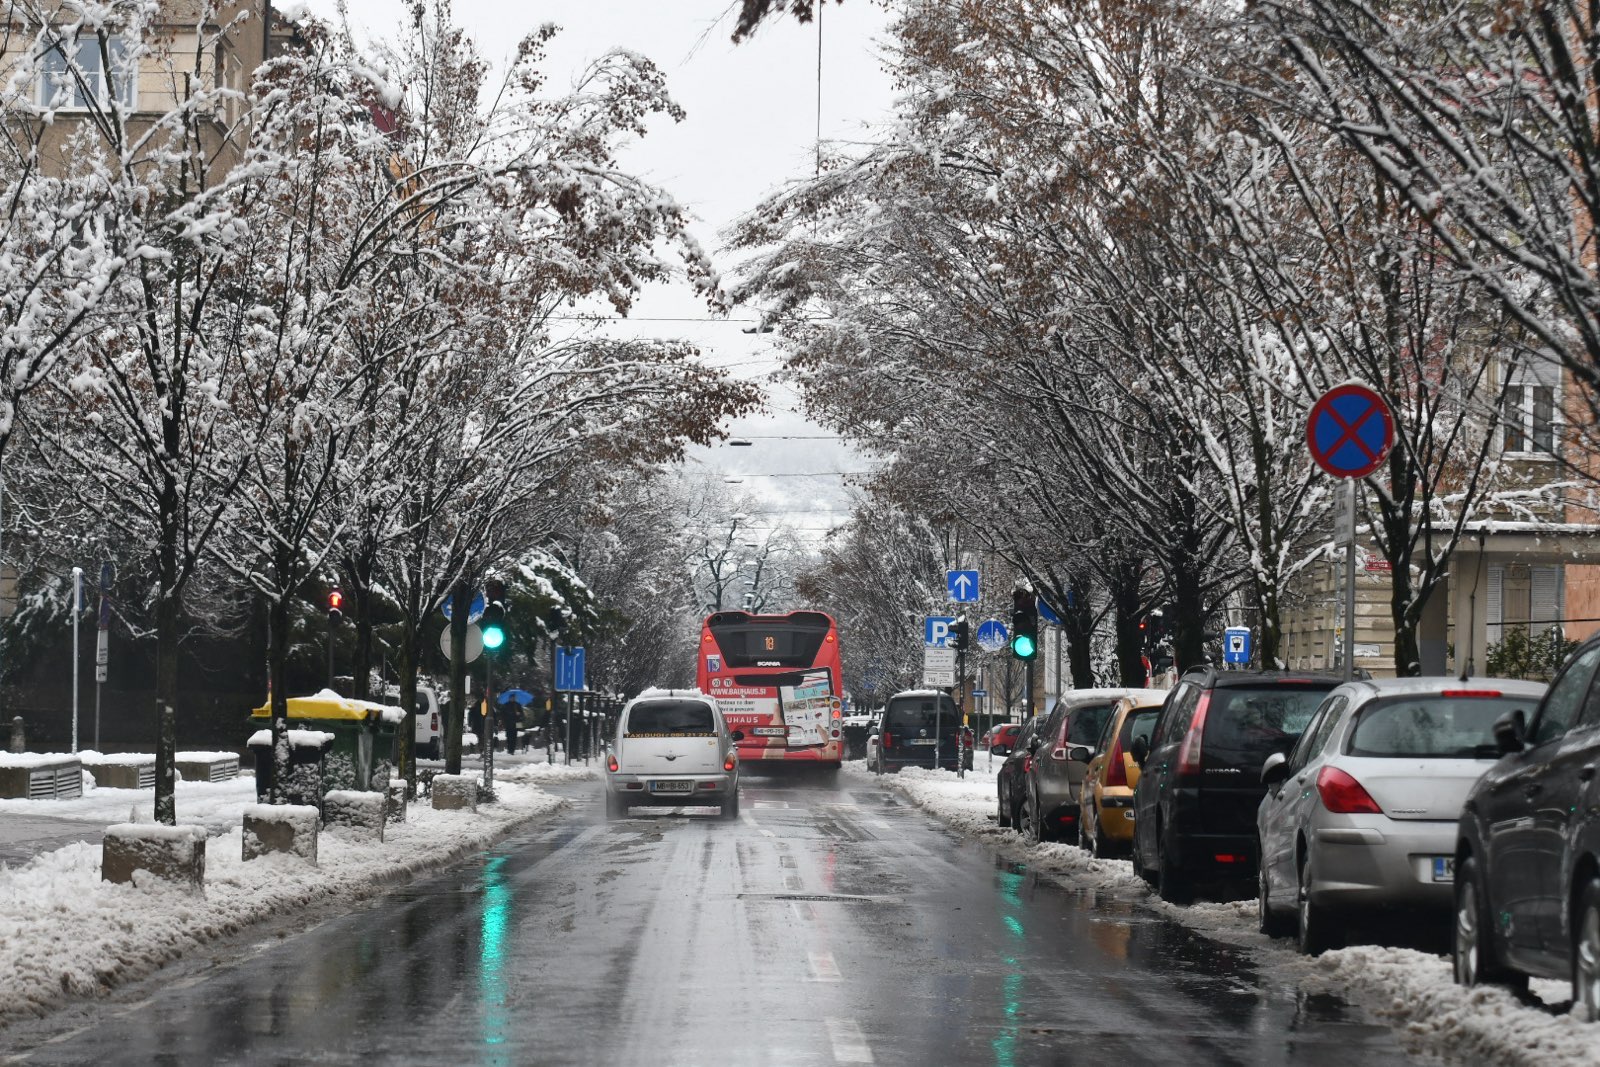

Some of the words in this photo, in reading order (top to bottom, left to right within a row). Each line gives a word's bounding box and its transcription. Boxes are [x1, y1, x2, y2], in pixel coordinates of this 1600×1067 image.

[932, 621, 949, 645] P
[710, 688, 767, 696] WWW.BAUHAUS.SI
[727, 716, 759, 724] UHAUS
